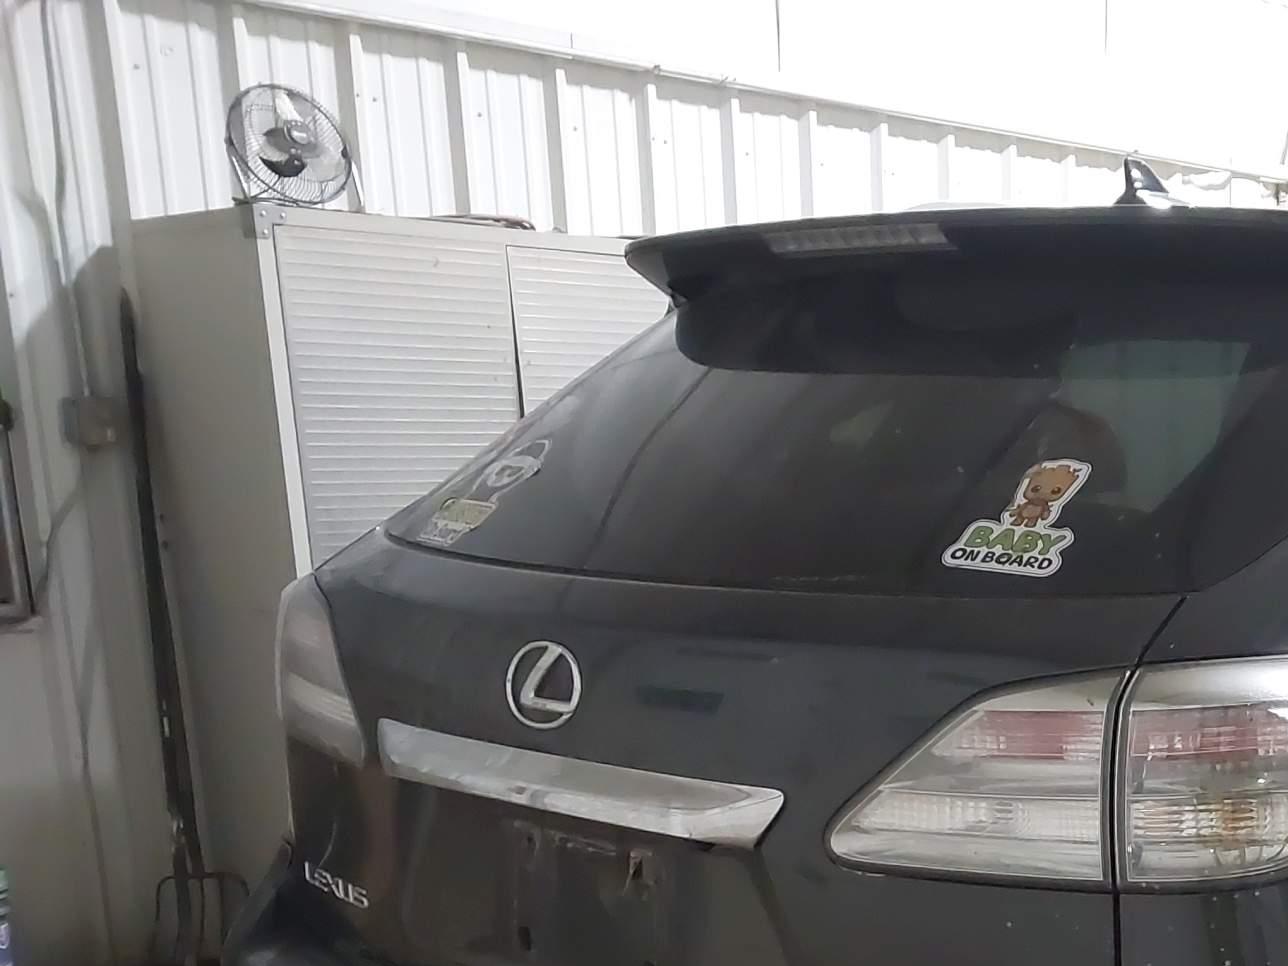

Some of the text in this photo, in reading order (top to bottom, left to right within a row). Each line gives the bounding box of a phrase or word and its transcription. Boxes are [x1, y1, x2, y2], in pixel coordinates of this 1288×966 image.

[963, 525, 1067, 555] BABY
[950, 548, 1053, 570] ON BOARD
[304, 861, 369, 908] LEXUS
